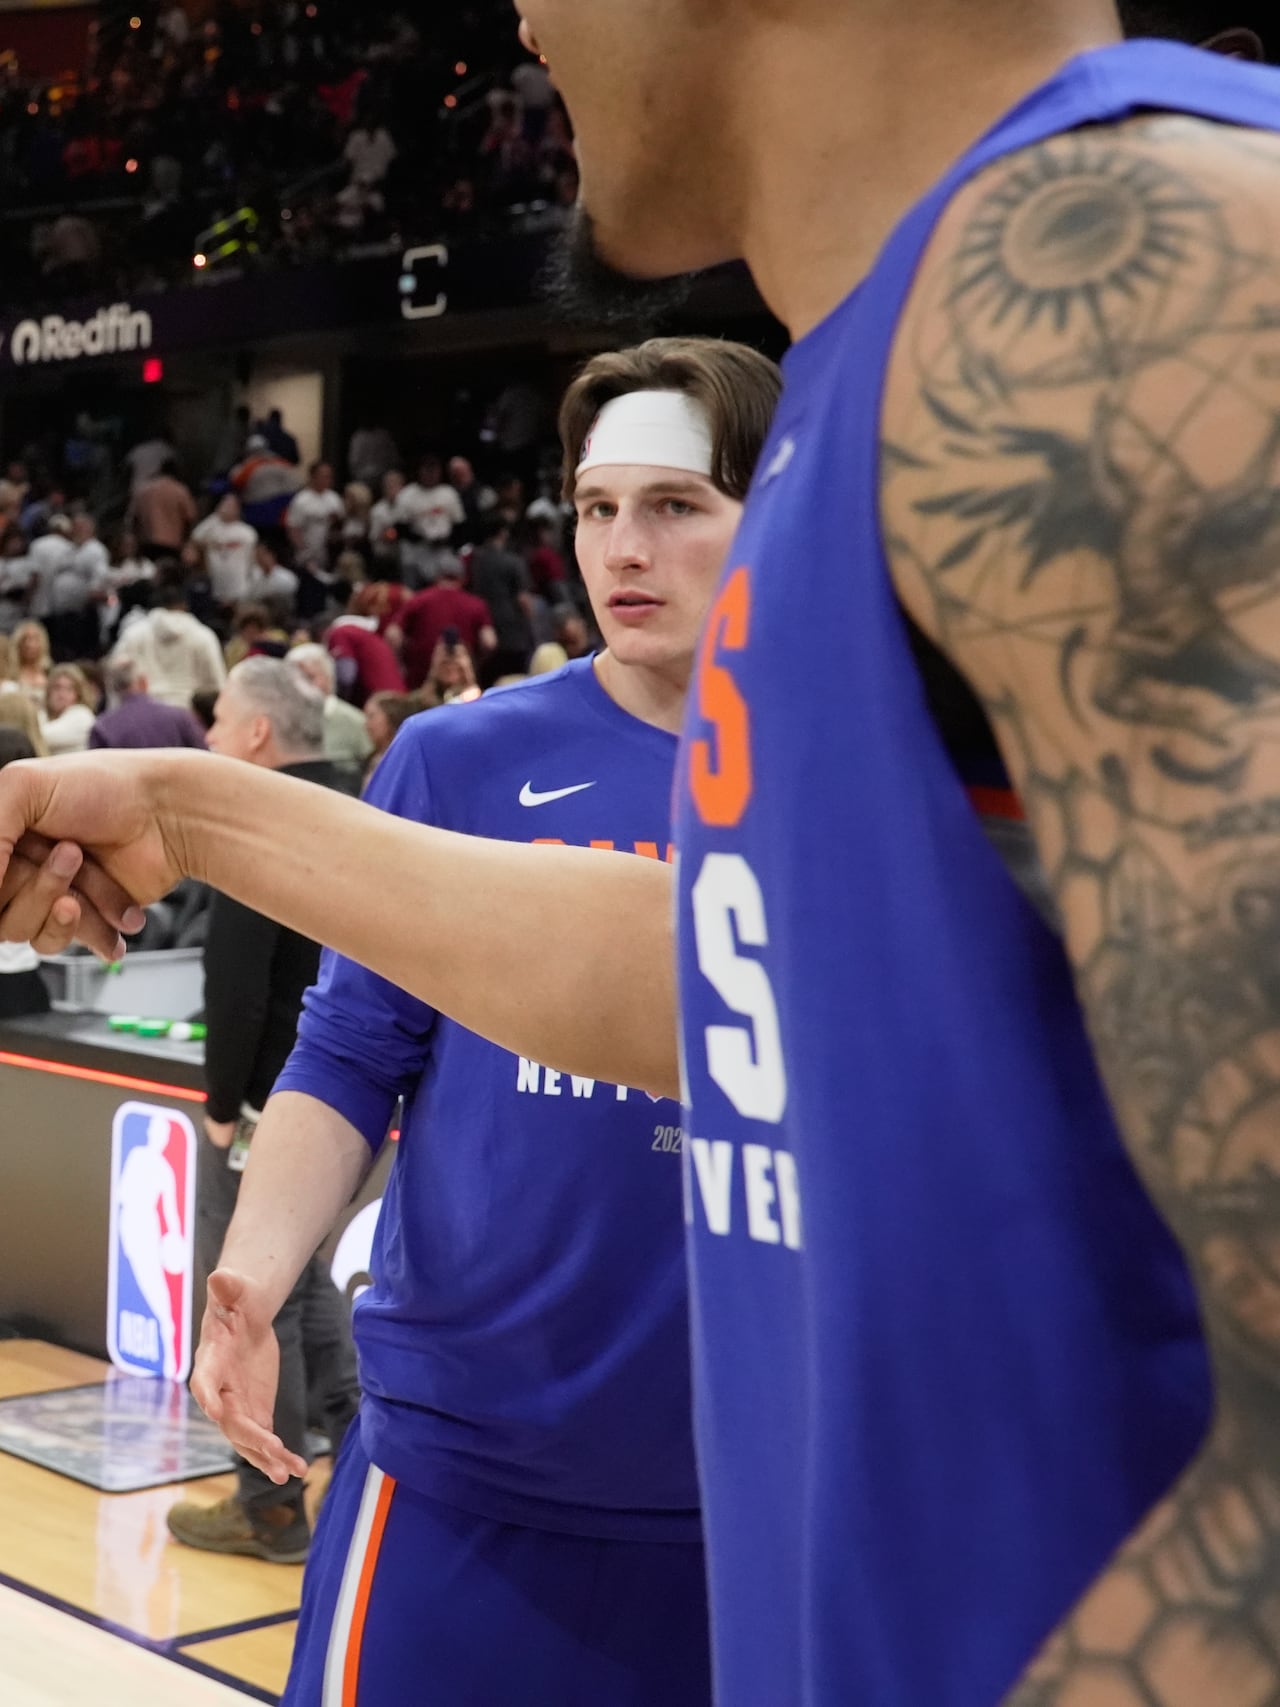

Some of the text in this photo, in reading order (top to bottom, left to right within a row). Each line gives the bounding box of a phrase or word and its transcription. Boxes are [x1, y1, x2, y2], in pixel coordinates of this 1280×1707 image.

[40, 302, 153, 363] Redfin
[516, 1056, 595, 1099] NEW
[651, 1125, 684, 1153] 202
